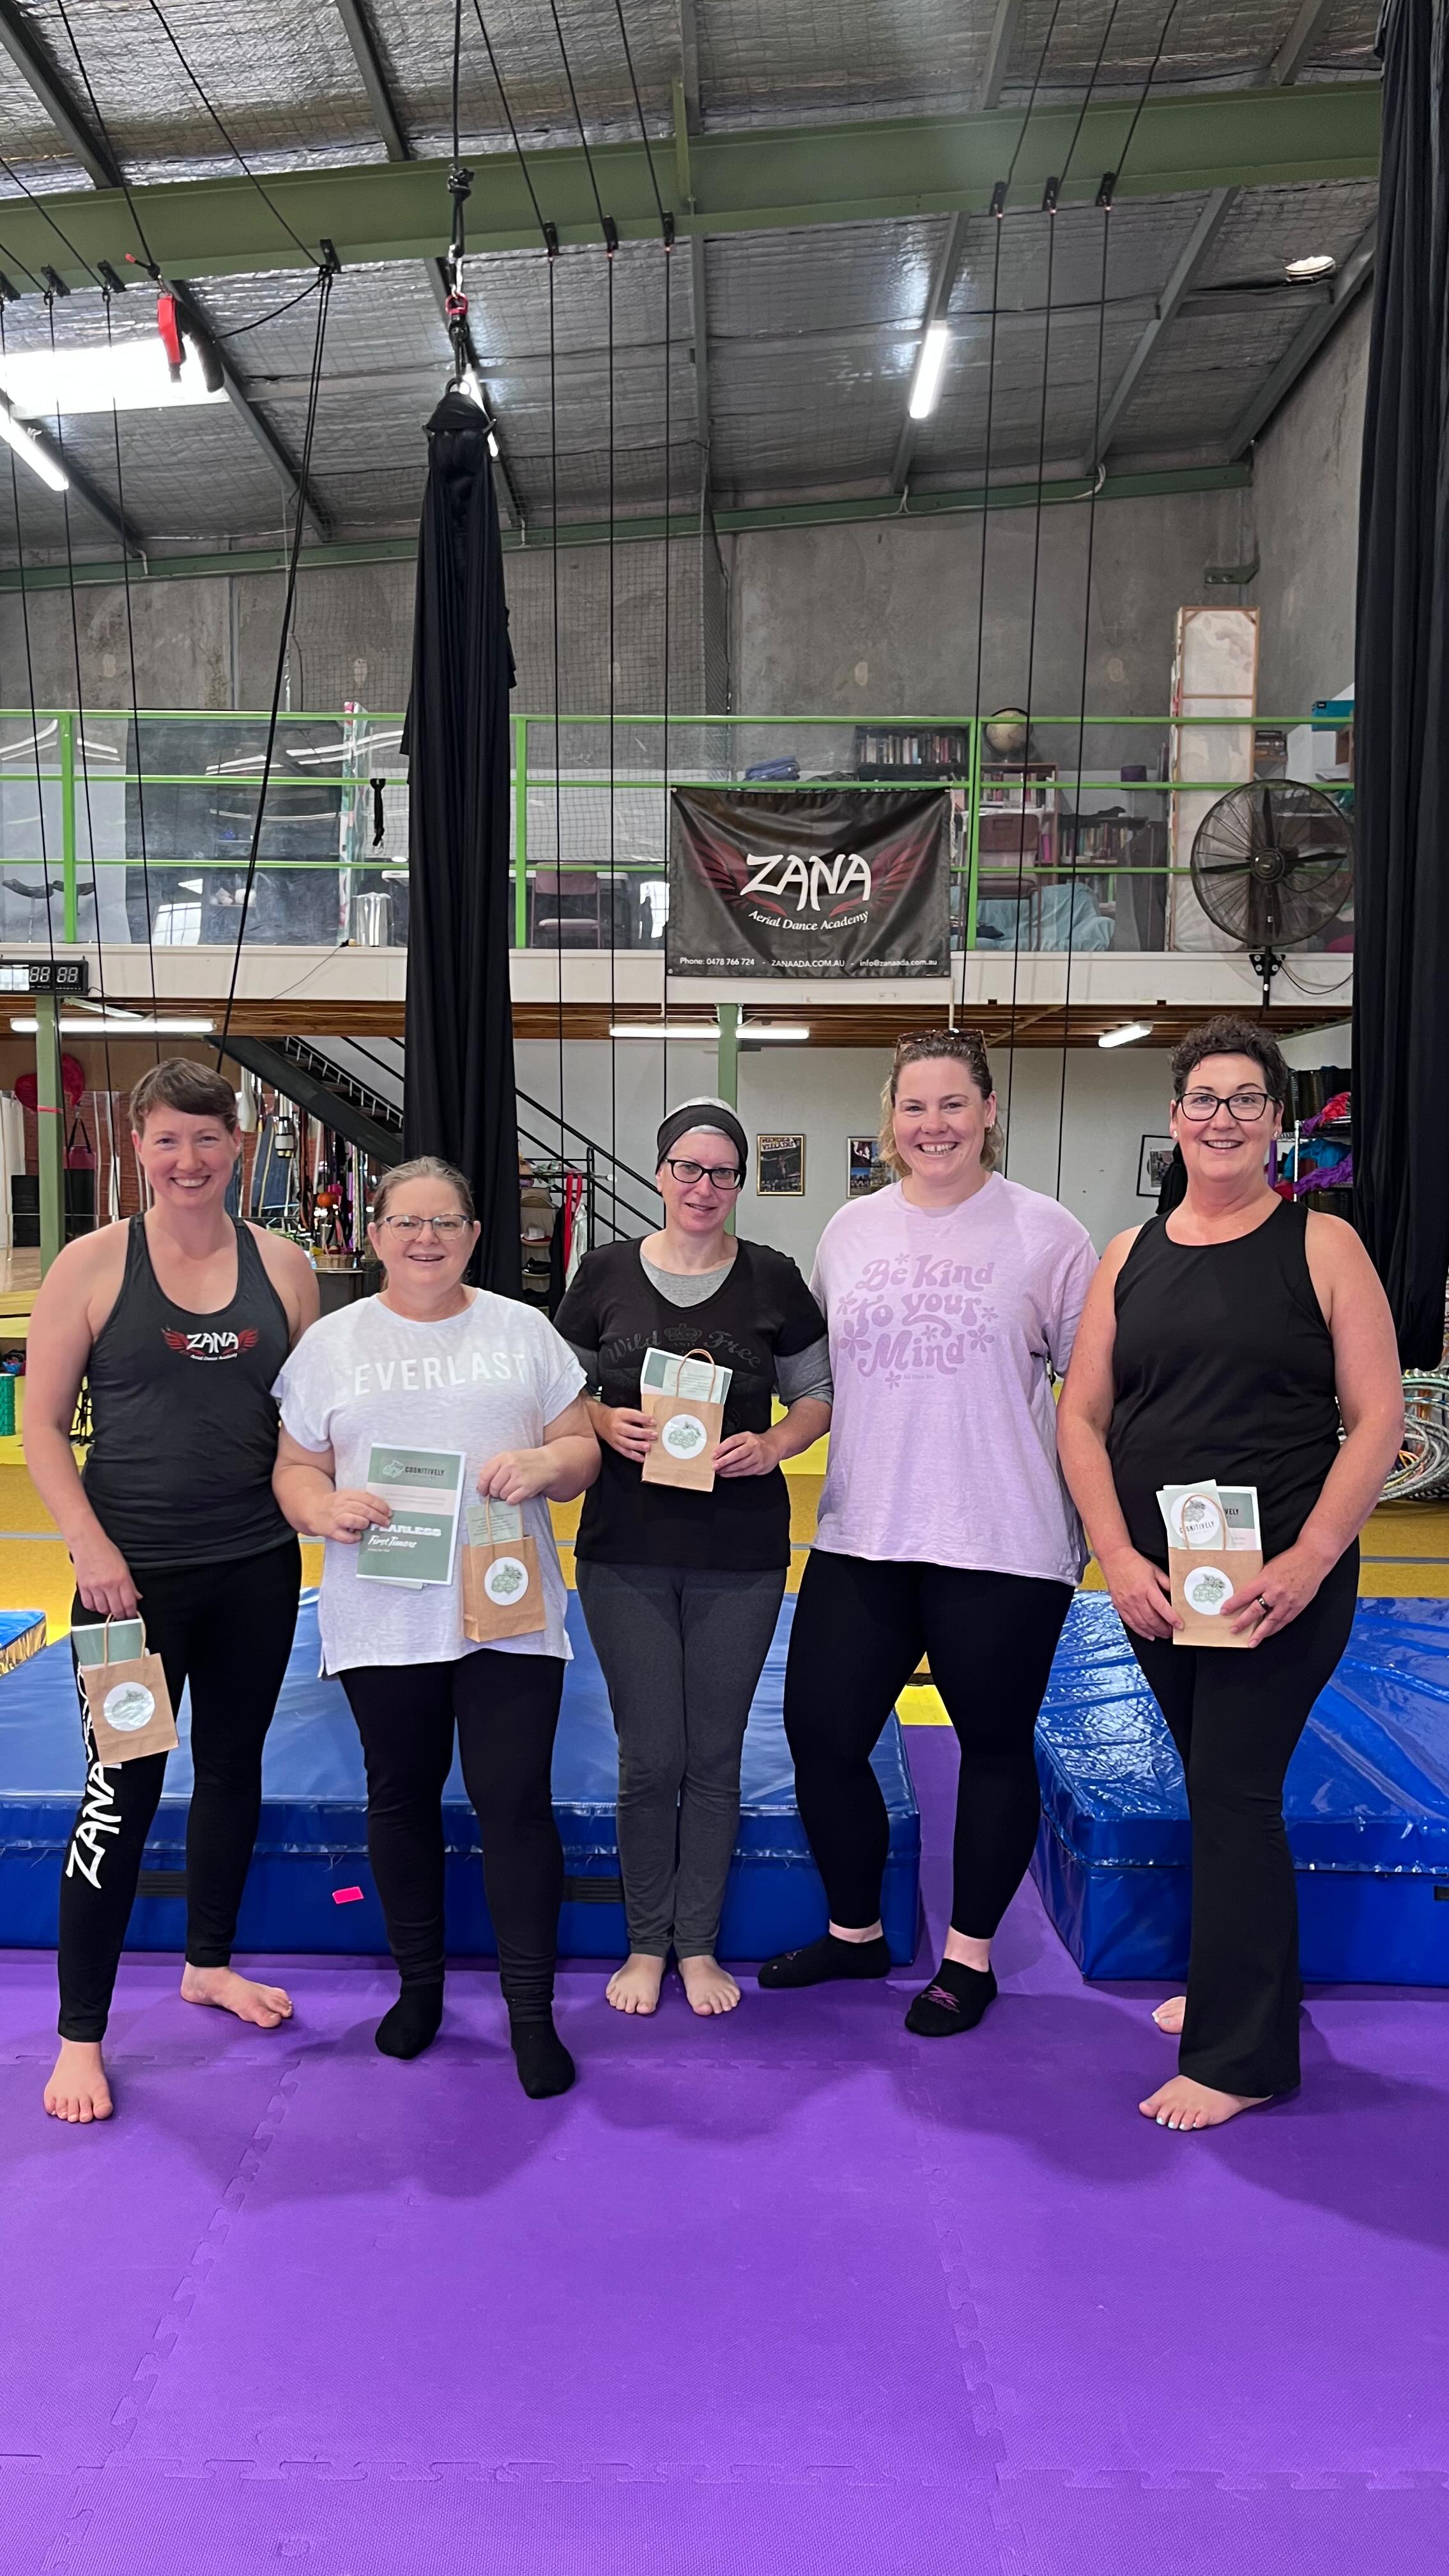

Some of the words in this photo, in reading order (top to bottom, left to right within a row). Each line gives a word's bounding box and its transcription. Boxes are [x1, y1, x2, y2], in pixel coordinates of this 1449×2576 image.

[740, 854, 871, 911] ZANA
[748, 910, 781, 927] Aerial
[782, 919, 818, 930] Dance
[820, 910, 869, 930] Academy
[679, 957, 705, 965] Phone:
[855, 1259, 908, 1292] Be
[912, 1254, 995, 1292] Kind
[850, 1294, 894, 1338] To
[186, 1332, 239, 1353] ZANA
[607, 1330, 661, 1364] Wild
[703, 1331, 761, 1368] Free
[857, 1330, 965, 1377] Mind
[354, 1351, 526, 1397] EVERLAST
[1179, 1521, 1215, 1533] CGNITIVELY
[66, 1761, 122, 1889] ZANA
